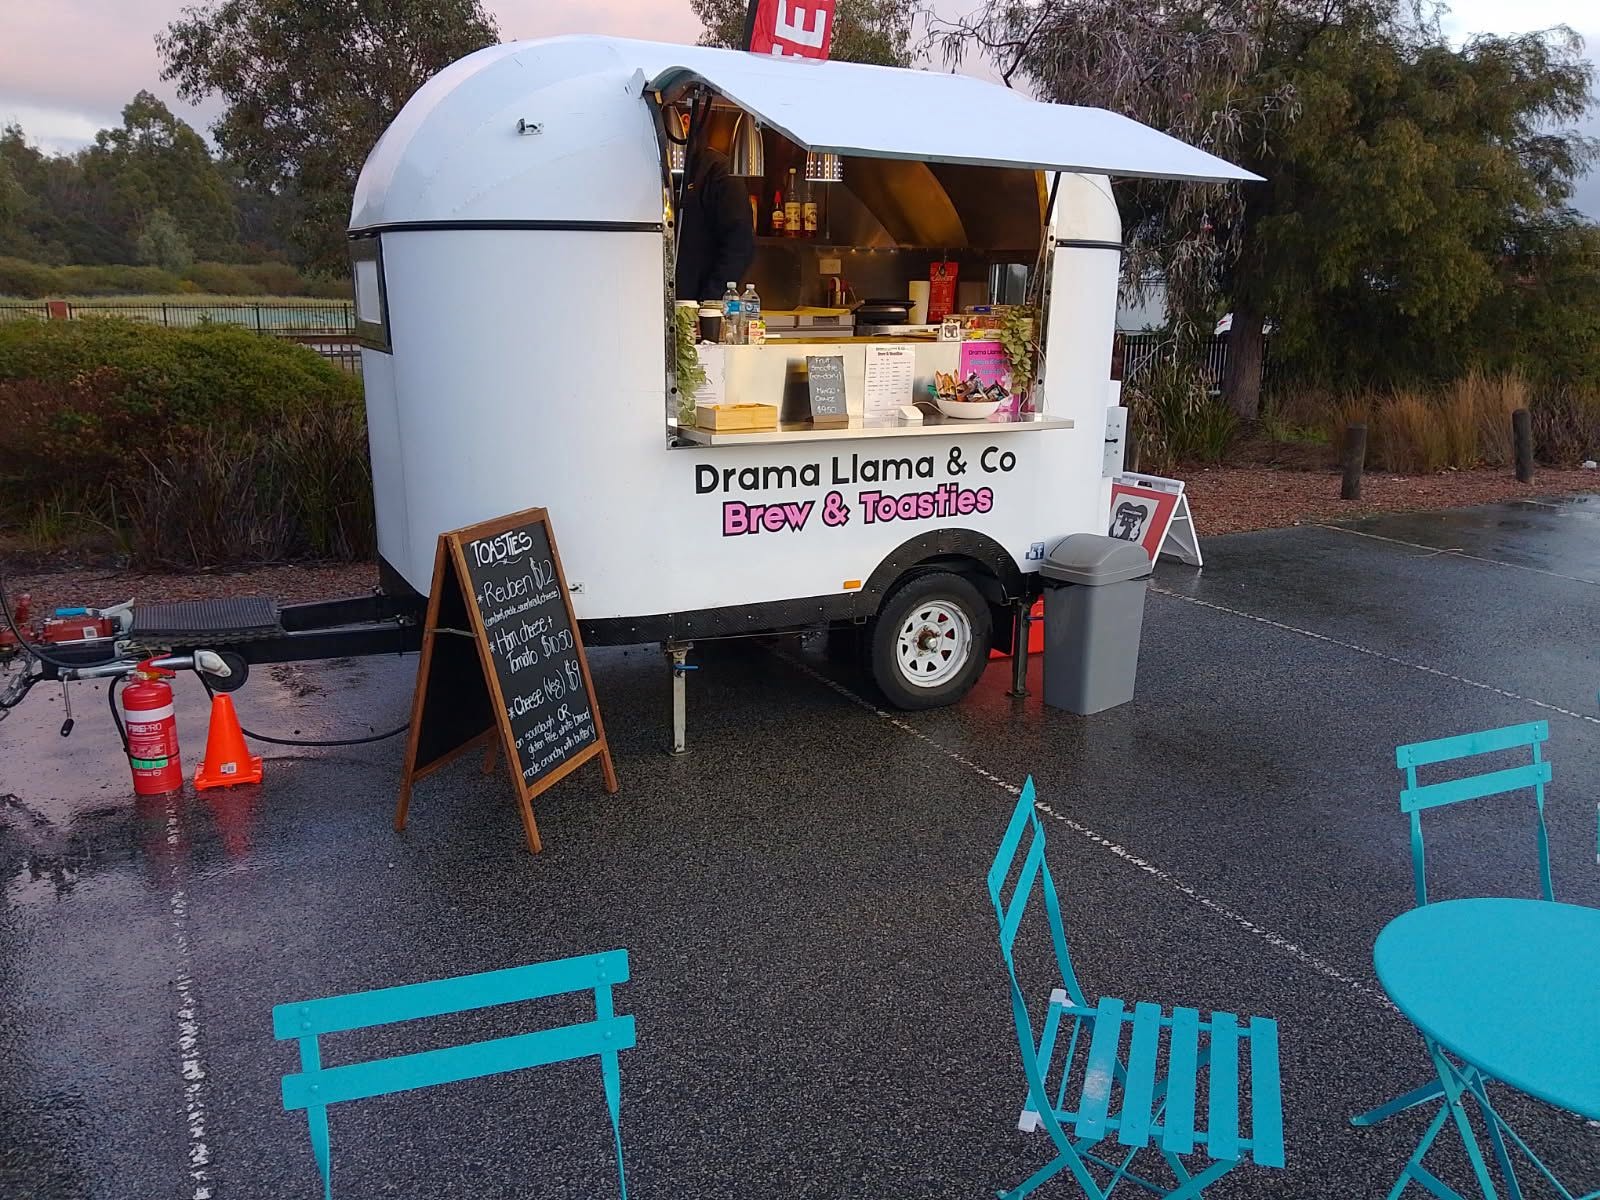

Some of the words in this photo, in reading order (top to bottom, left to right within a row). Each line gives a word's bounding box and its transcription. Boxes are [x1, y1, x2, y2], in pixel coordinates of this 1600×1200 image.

[695, 463, 820, 494] Drama
[831, 453, 934, 485] Llama
[946, 446, 968, 476] &
[980, 446, 1016, 473] Co
[722, 500, 816, 537] Brew
[821, 490, 851, 527] &
[858, 482, 994, 524] Toasties
[470, 531, 533, 568] TOASTIES
[483, 574, 534, 608] Reuben
[529, 556, 555, 591] $12
[505, 645, 539, 674] Tomato
[513, 688, 545, 716] Cheese
[564, 659, 583, 692] $9
[515, 737, 525, 749] on
[557, 703, 572, 722] OR
[572, 706, 591, 726] bread
[522, 761, 541, 780] made
